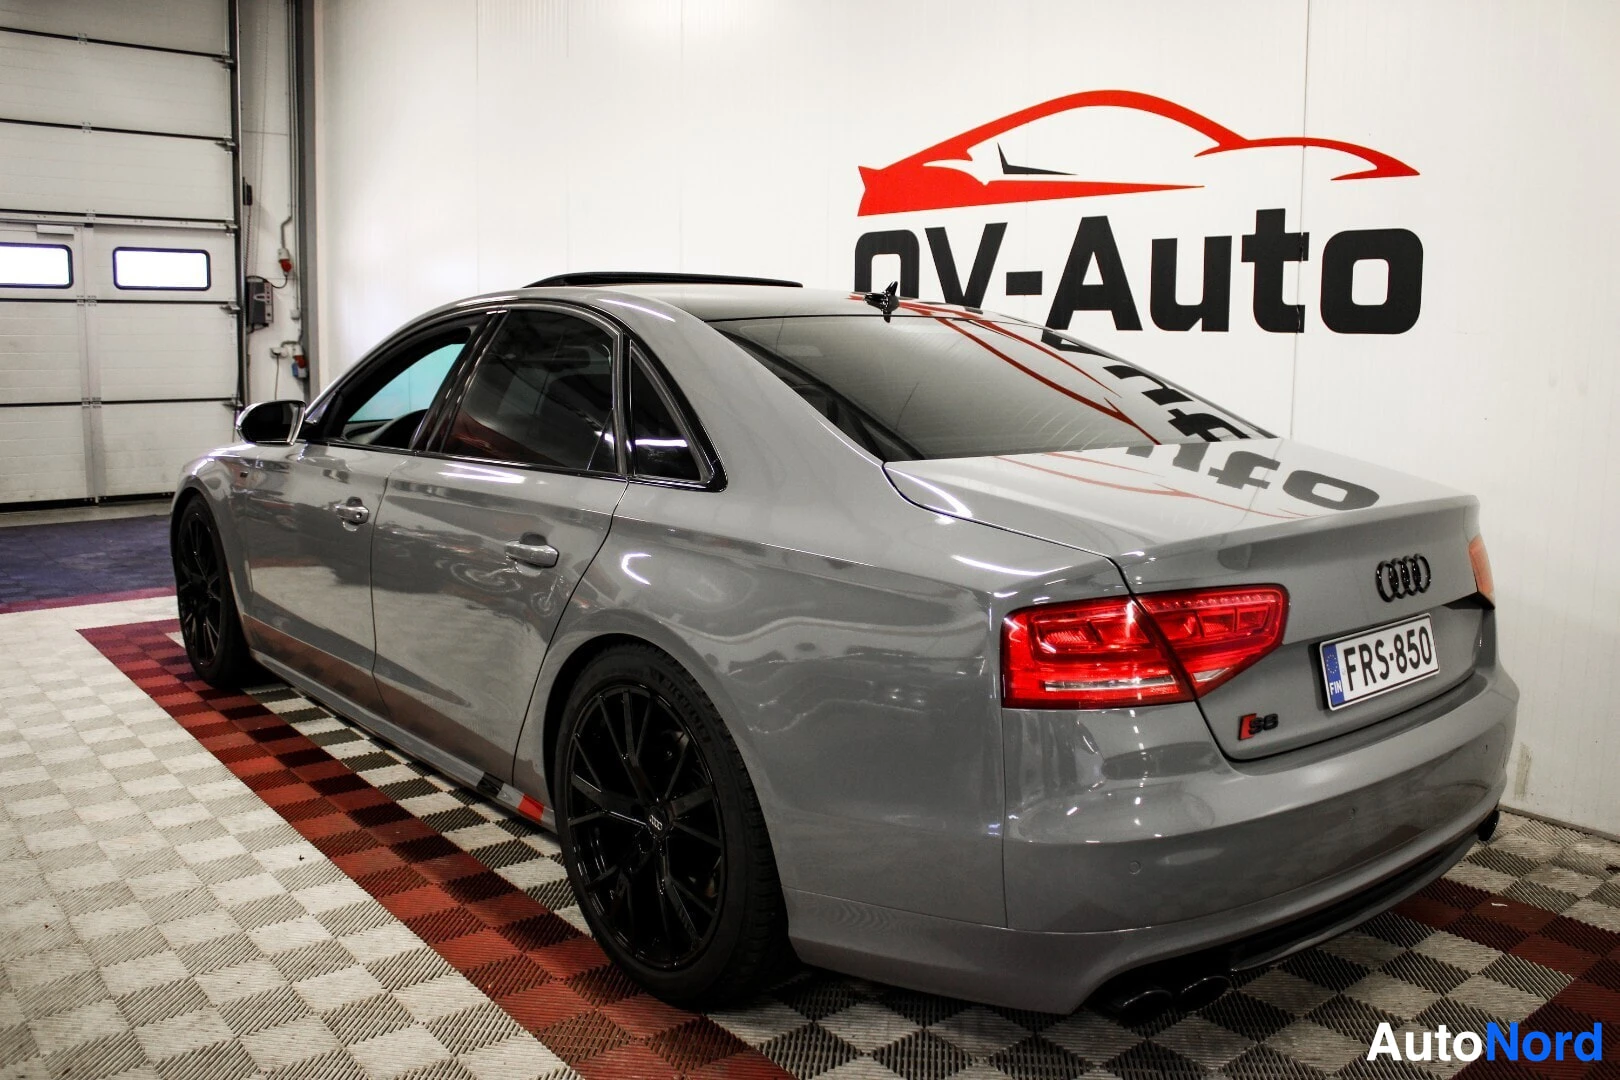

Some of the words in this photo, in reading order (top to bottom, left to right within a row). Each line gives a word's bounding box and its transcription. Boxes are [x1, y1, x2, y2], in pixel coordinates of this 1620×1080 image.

[854, 208, 1424, 334] OV-Auto
[1329, 680, 1343, 697] FIN
[1343, 626, 1432, 692] FRS-850
